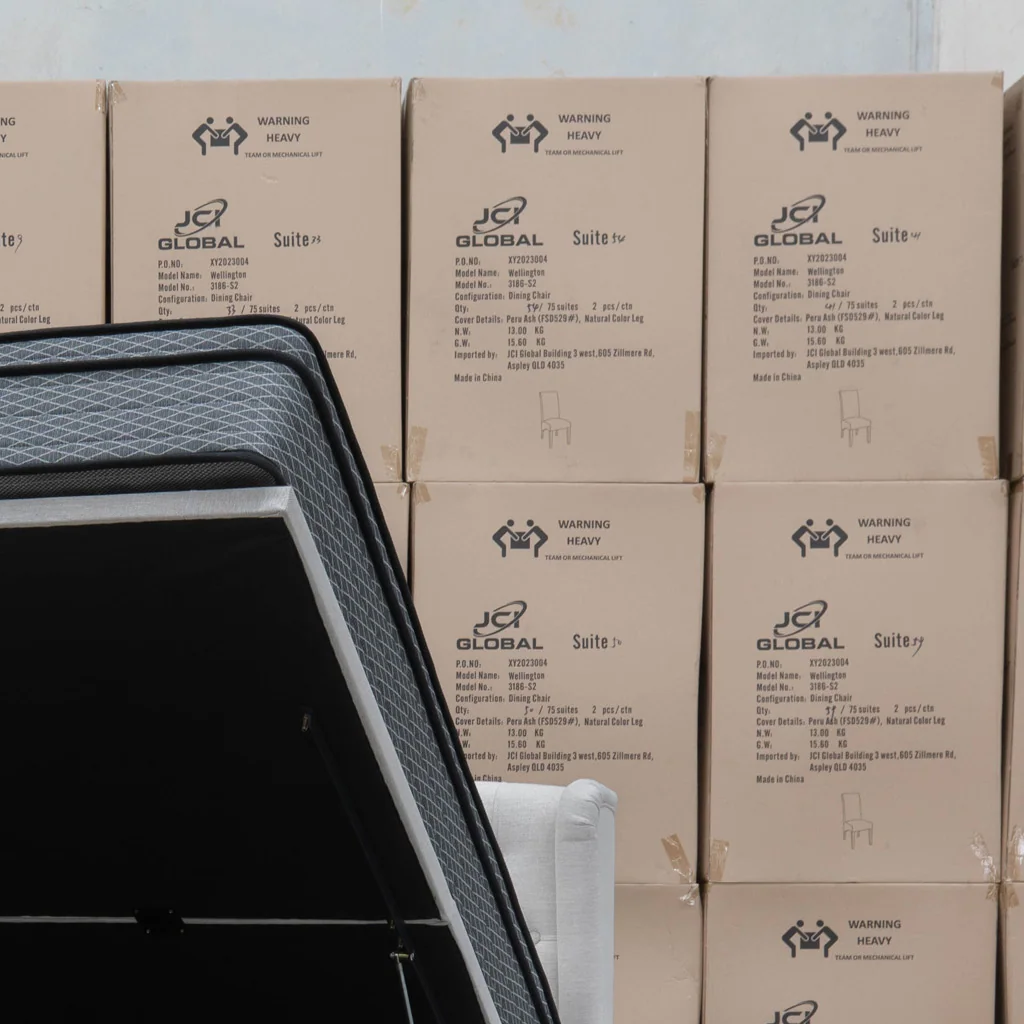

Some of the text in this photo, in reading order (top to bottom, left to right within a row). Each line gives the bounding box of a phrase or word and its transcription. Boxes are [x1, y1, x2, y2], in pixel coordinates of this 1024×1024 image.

[559, 114, 611, 123] WARNING
[857, 111, 910, 120] WARNING
[258, 116, 310, 126] WARNING
[267, 133, 300, 142] HEAVY
[567, 131, 602, 140] HEAVY
[866, 128, 901, 137] HEAVY
[175, 205, 225, 231] JCI
[473, 202, 524, 229] JCI
[771, 200, 822, 228] JCI
[274, 232, 309, 247] Suite
[573, 230, 608, 245] Suite
[754, 232, 842, 246] GLOBAL
[872, 227, 908, 243] Suite
[158, 236, 244, 250] GLOBAL
[456, 234, 543, 247] GLOBAL
[455, 351, 485, 359] Imported
[508, 350, 518, 358] JCI
[520, 350, 541, 358] Global
[543, 349, 572, 359] Building
[613, 349, 642, 357] Zillmere
[508, 362, 530, 371] Aspley
[547, 361, 565, 369] 4035
[558, 520, 610, 529] WARNING
[858, 518, 911, 527] WARNING
[567, 537, 601, 546] HEAVY
[867, 535, 901, 544] HEAVY
[473, 606, 524, 632] JCI
[774, 606, 824, 632] JCI
[456, 637, 543, 651] GLOBAL
[573, 634, 608, 649] Suite
[757, 637, 844, 650] GLOBAL
[874, 633, 909, 648] Suite
[809, 659, 849, 667] XY2023004
[757, 672, 778, 680] Model
[809, 671, 846, 680] Wellington
[848, 920, 901, 929] WARNING
[857, 937, 892, 945] HEAVY
